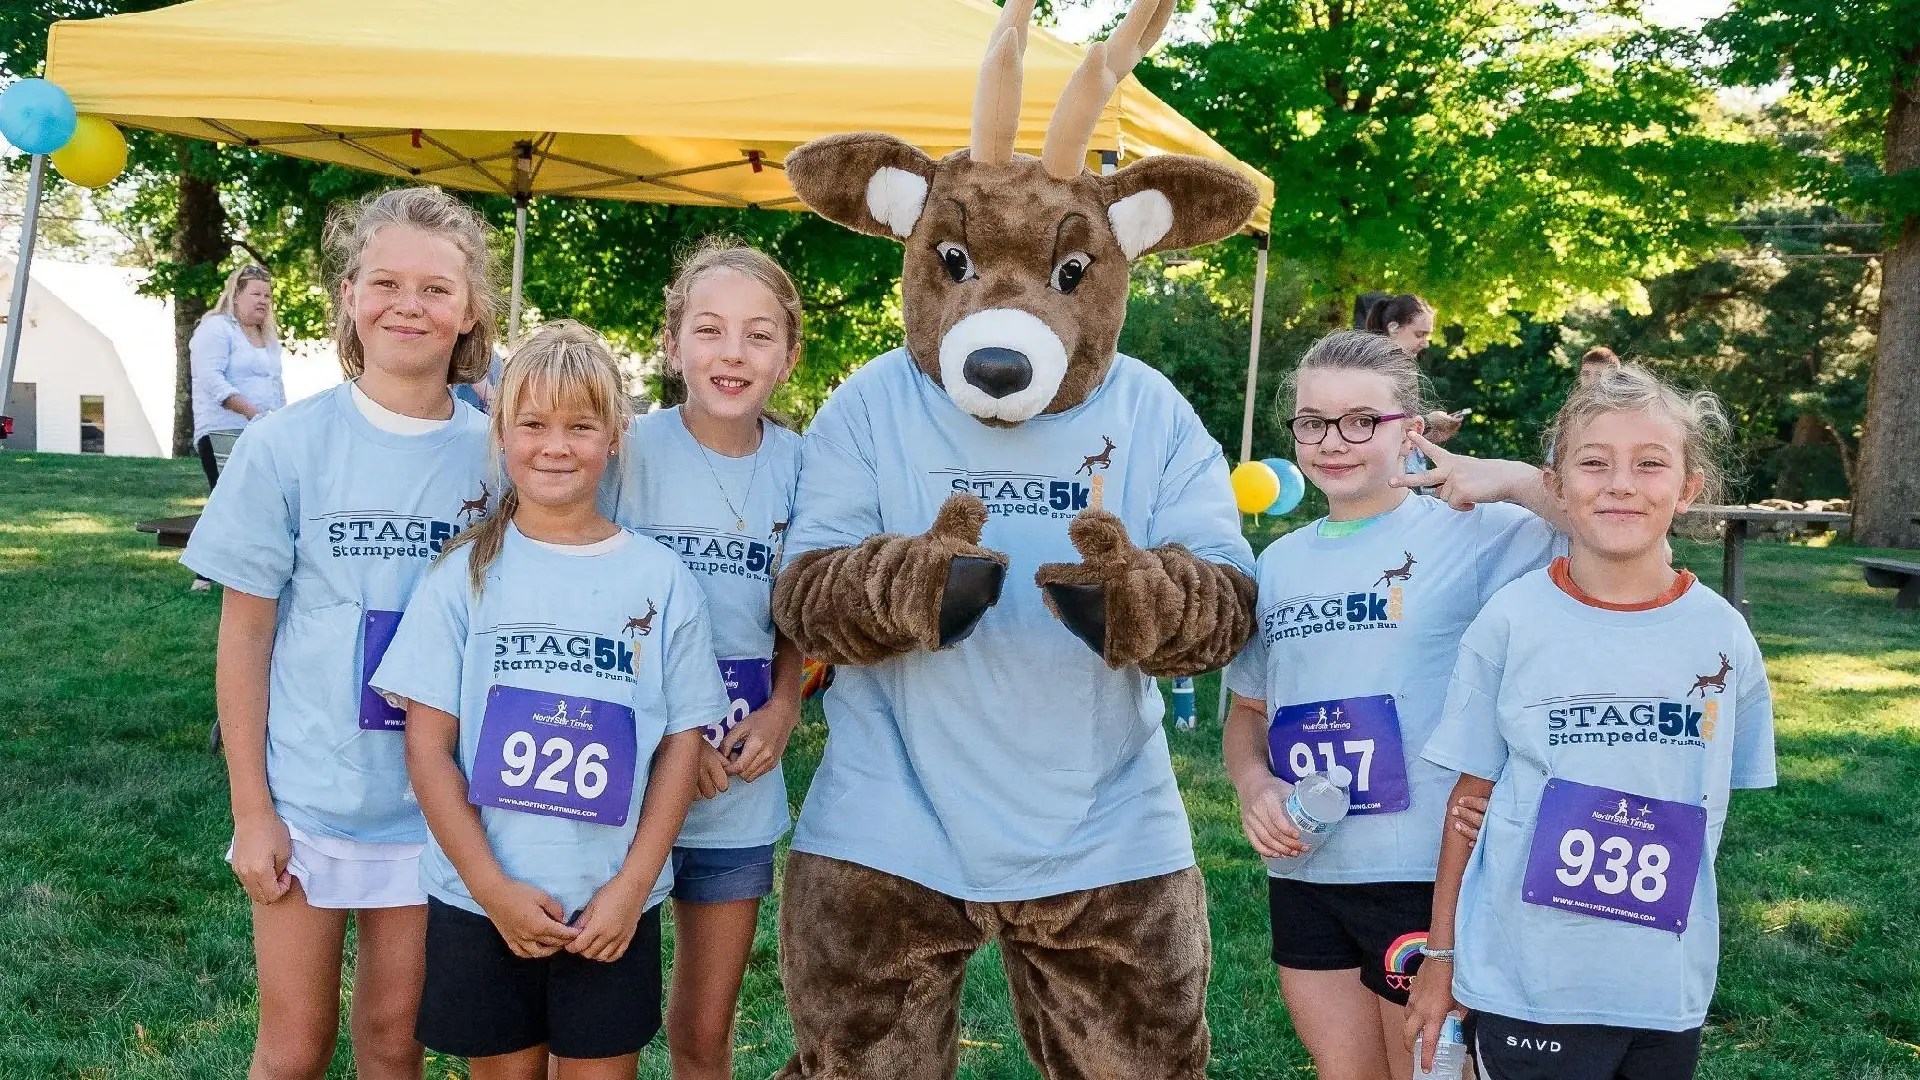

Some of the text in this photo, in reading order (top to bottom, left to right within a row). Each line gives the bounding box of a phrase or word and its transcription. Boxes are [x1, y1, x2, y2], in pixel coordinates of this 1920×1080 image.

[951, 479, 1045, 502] STAG
[1049, 481, 1089, 511] 5k
[987, 503, 1049, 516] mpede
[328, 520, 460, 553] STAG 5
[655, 535, 745, 560] STAG
[332, 544, 429, 560] Stampede
[683, 561, 745, 576] mpede
[1265, 593, 1388, 634] STAG 5k
[1265, 619, 1346, 648] Stampede
[493, 659, 594, 674] Stampede
[495, 635, 591, 659] STAG
[594, 637, 634, 675] 5k
[570, 718, 594, 731] Timing
[1549, 702, 1703, 738] STAG 5k
[1549, 728, 1658, 746] Stampede
[501, 731, 610, 799] 926
[1289, 739, 1375, 792] 917
[1629, 816, 1655, 831] Timing
[1556, 829, 1671, 903] 938
